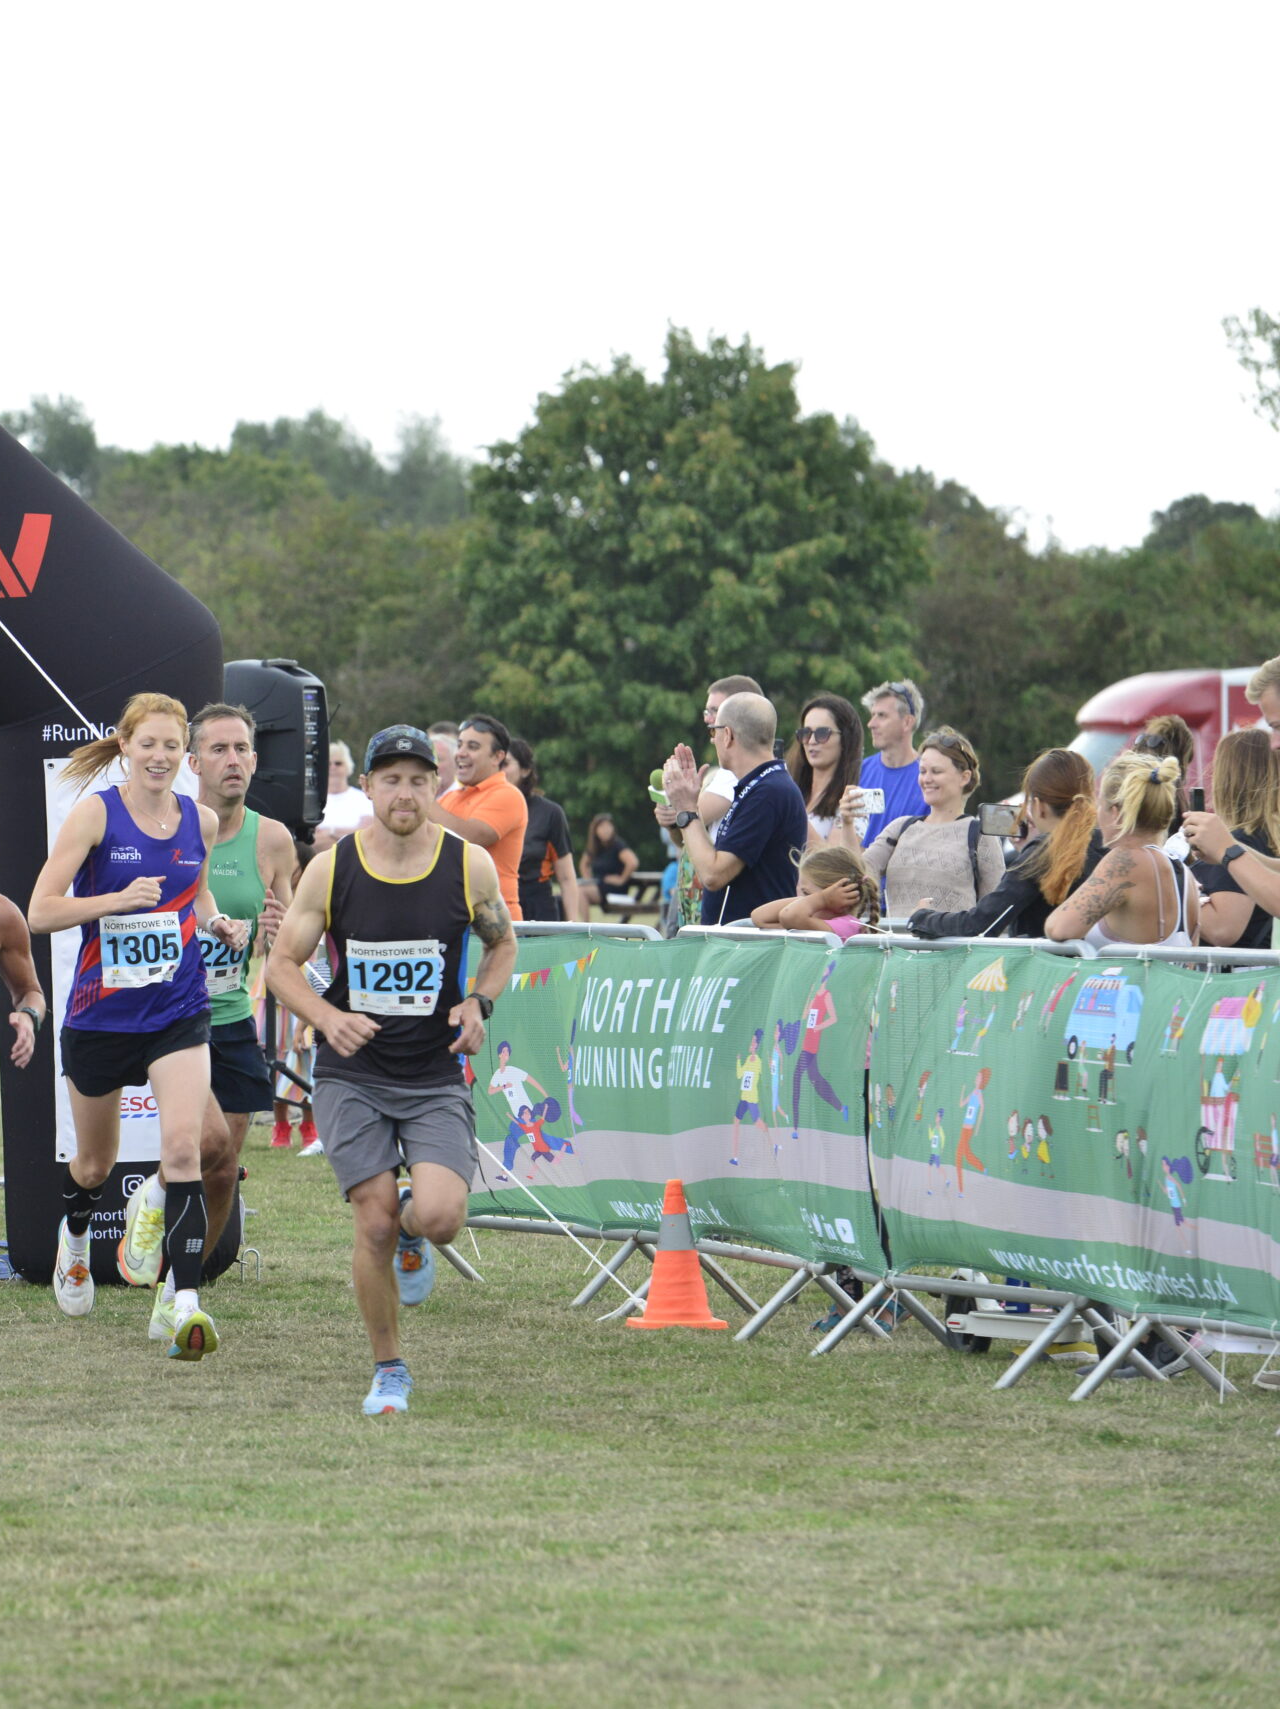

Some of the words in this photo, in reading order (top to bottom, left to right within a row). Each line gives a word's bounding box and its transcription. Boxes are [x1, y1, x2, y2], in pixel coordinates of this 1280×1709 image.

[42, 723, 117, 742] #RunNo
[110, 848, 142, 861] marsh
[104, 920, 161, 930] NORTHSTOWE
[106, 933, 180, 965] 1305
[351, 947, 415, 957] NORTHSTOWE
[418, 947, 434, 955] 10K
[353, 961, 434, 992] 1292
[574, 1045, 663, 1089] RUNNING
[121, 1096, 158, 1112] ESC
